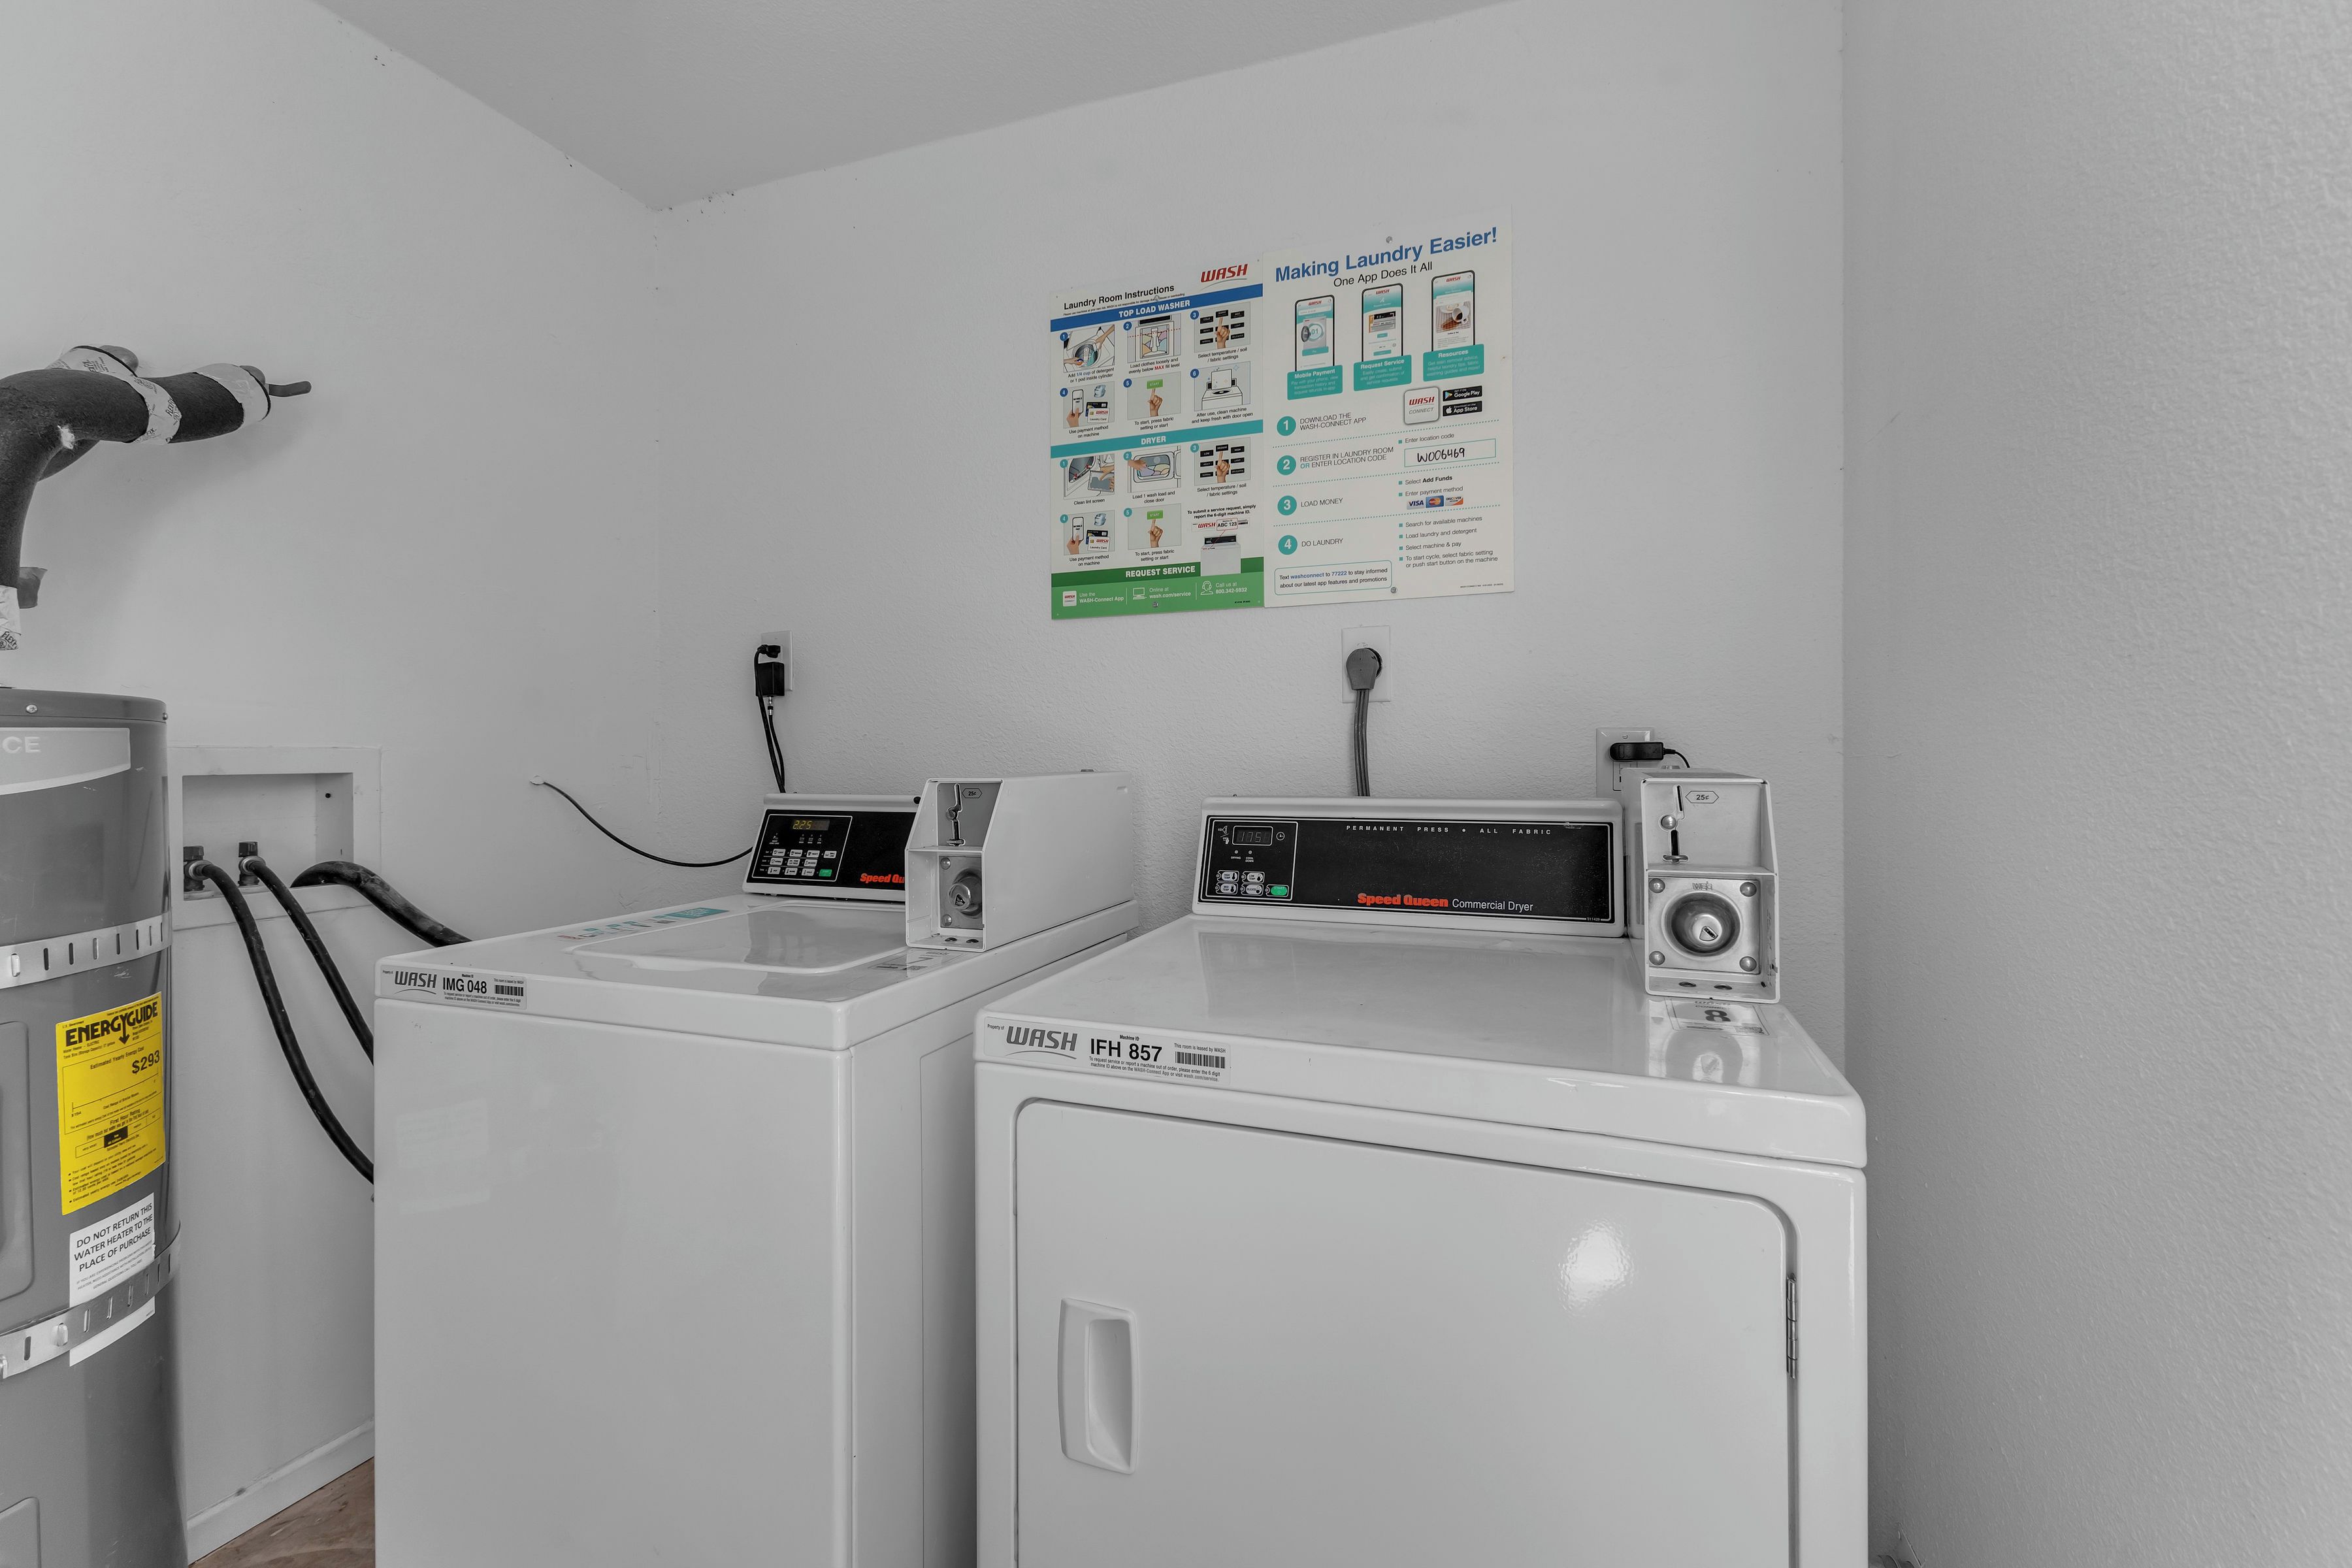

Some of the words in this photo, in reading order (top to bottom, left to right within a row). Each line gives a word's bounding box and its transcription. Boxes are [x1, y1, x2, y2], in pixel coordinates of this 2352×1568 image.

[1275, 260, 1339, 282] Making
[1346, 244, 1423, 270] Laundry
[1430, 227, 1497, 255] Easier!
[1201, 264, 1248, 282] WASH
[1333, 276, 1354, 287] One
[1358, 271, 1377, 285] App
[1381, 267, 1407, 280] Does
[1411, 265, 1416, 274] It
[1419, 261, 1433, 272] All
[1064, 299, 1096, 310] Laundry
[1099, 295, 1122, 304] Room
[1125, 285, 1175, 299] Instructions
[1135, 306, 1156, 315] LOAD
[1158, 299, 1190, 312] WASHER
[1360, 361, 1382, 370] Request
[1295, 370, 1311, 379] Mobile
[1313, 368, 1335, 378] Payment
[1409, 396, 1435, 405] WASH
[1283, 419, 1288, 431] 1
[1300, 414, 1337, 425] DOWNLOAD
[1300, 419, 1351, 431] WASH-CONNECT
[1141, 435, 1166, 445] DRYER
[1300, 453, 1330, 463] REGISTER
[1341, 449, 1371, 458] LAUNDRY
[1333, 457, 1365, 466] LOCATION
[1417, 448, 1465, 463] W006469
[1283, 459, 1290, 470] 2
[1283, 499, 1291, 510] 3
[1284, 538, 1291, 549] 4
[1125, 568, 1160, 578] REQUEST
[1163, 566, 1196, 575] SERVICE
[860, 873, 891, 883] Speed
[1358, 892, 1401, 906] Speed
[1403, 894, 1448, 907] Queen
[1452, 899, 1505, 910] Commercial
[1508, 902, 1534, 913] Dryer
[395, 971, 437, 988] WASH
[443, 977, 465, 992] IMG
[467, 980, 487, 994] 048
[65, 1001, 158, 1047] ENERGYGUIDE
[1006, 1026, 1078, 1051] WASH
[1091, 1038, 1121, 1057] IFH
[1129, 1043, 1162, 1062] 857
[132, 1050, 159, 1075] $293
[76, 1236, 90, 1248] DO
[93, 1226, 111, 1241] NOT
[112, 1211, 140, 1232] RETURN
[141, 1202, 152, 1216] THIS
[74, 1240, 105, 1261] WATER
[107, 1226, 133, 1247] HEATER
[135, 1221, 142, 1231] TO
[144, 1214, 153, 1225] THE
[79, 1253, 106, 1272] PLACE
[108, 1247, 118, 1258] OF
[119, 1227, 150, 1252] PURCHASE
